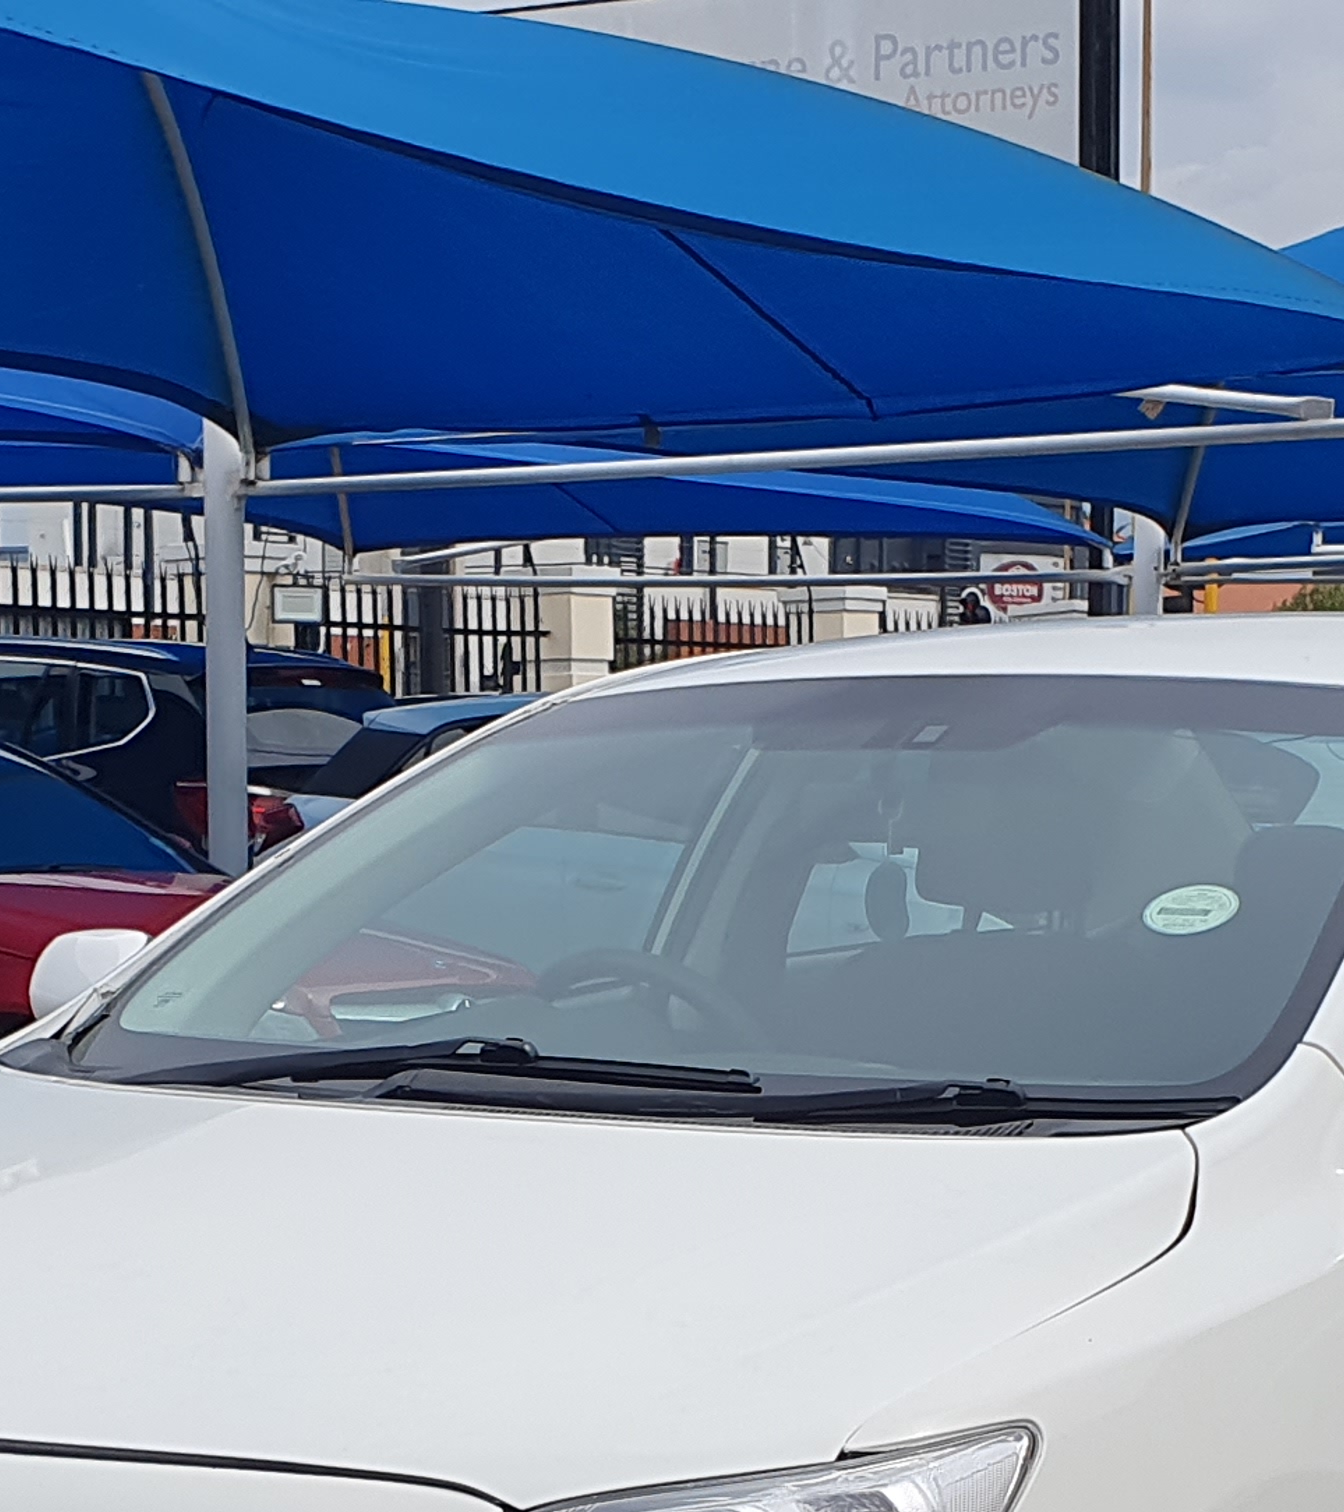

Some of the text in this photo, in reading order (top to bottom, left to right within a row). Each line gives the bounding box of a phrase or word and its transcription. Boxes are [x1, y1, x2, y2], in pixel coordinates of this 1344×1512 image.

[823, 31, 1061, 85] & Partners
[905, 82, 1060, 121] Attorneys
